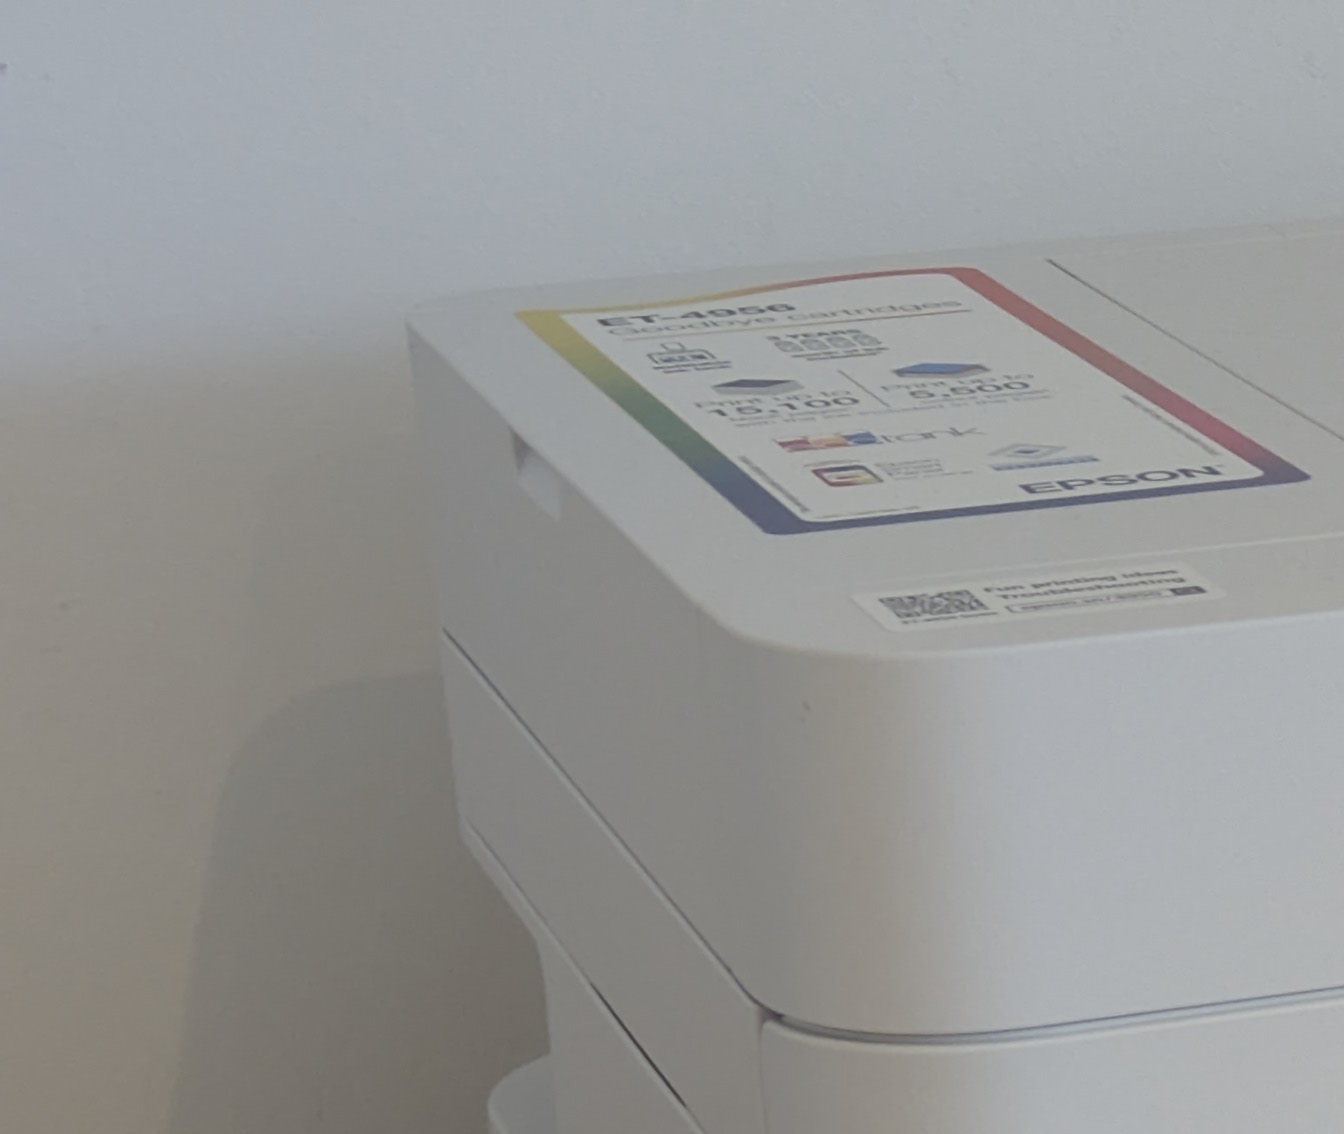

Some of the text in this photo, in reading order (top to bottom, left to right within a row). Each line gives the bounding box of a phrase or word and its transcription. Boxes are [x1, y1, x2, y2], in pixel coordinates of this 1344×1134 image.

[597, 303, 796, 327] ET-4956
[608, 300, 963, 336] Goodbye cartridges
[1018, 465, 1222, 495] EPSON
[996, 576, 1187, 601] Troubleshooting
[1030, 574, 1118, 590] printing
[1120, 569, 1179, 580] ideas
